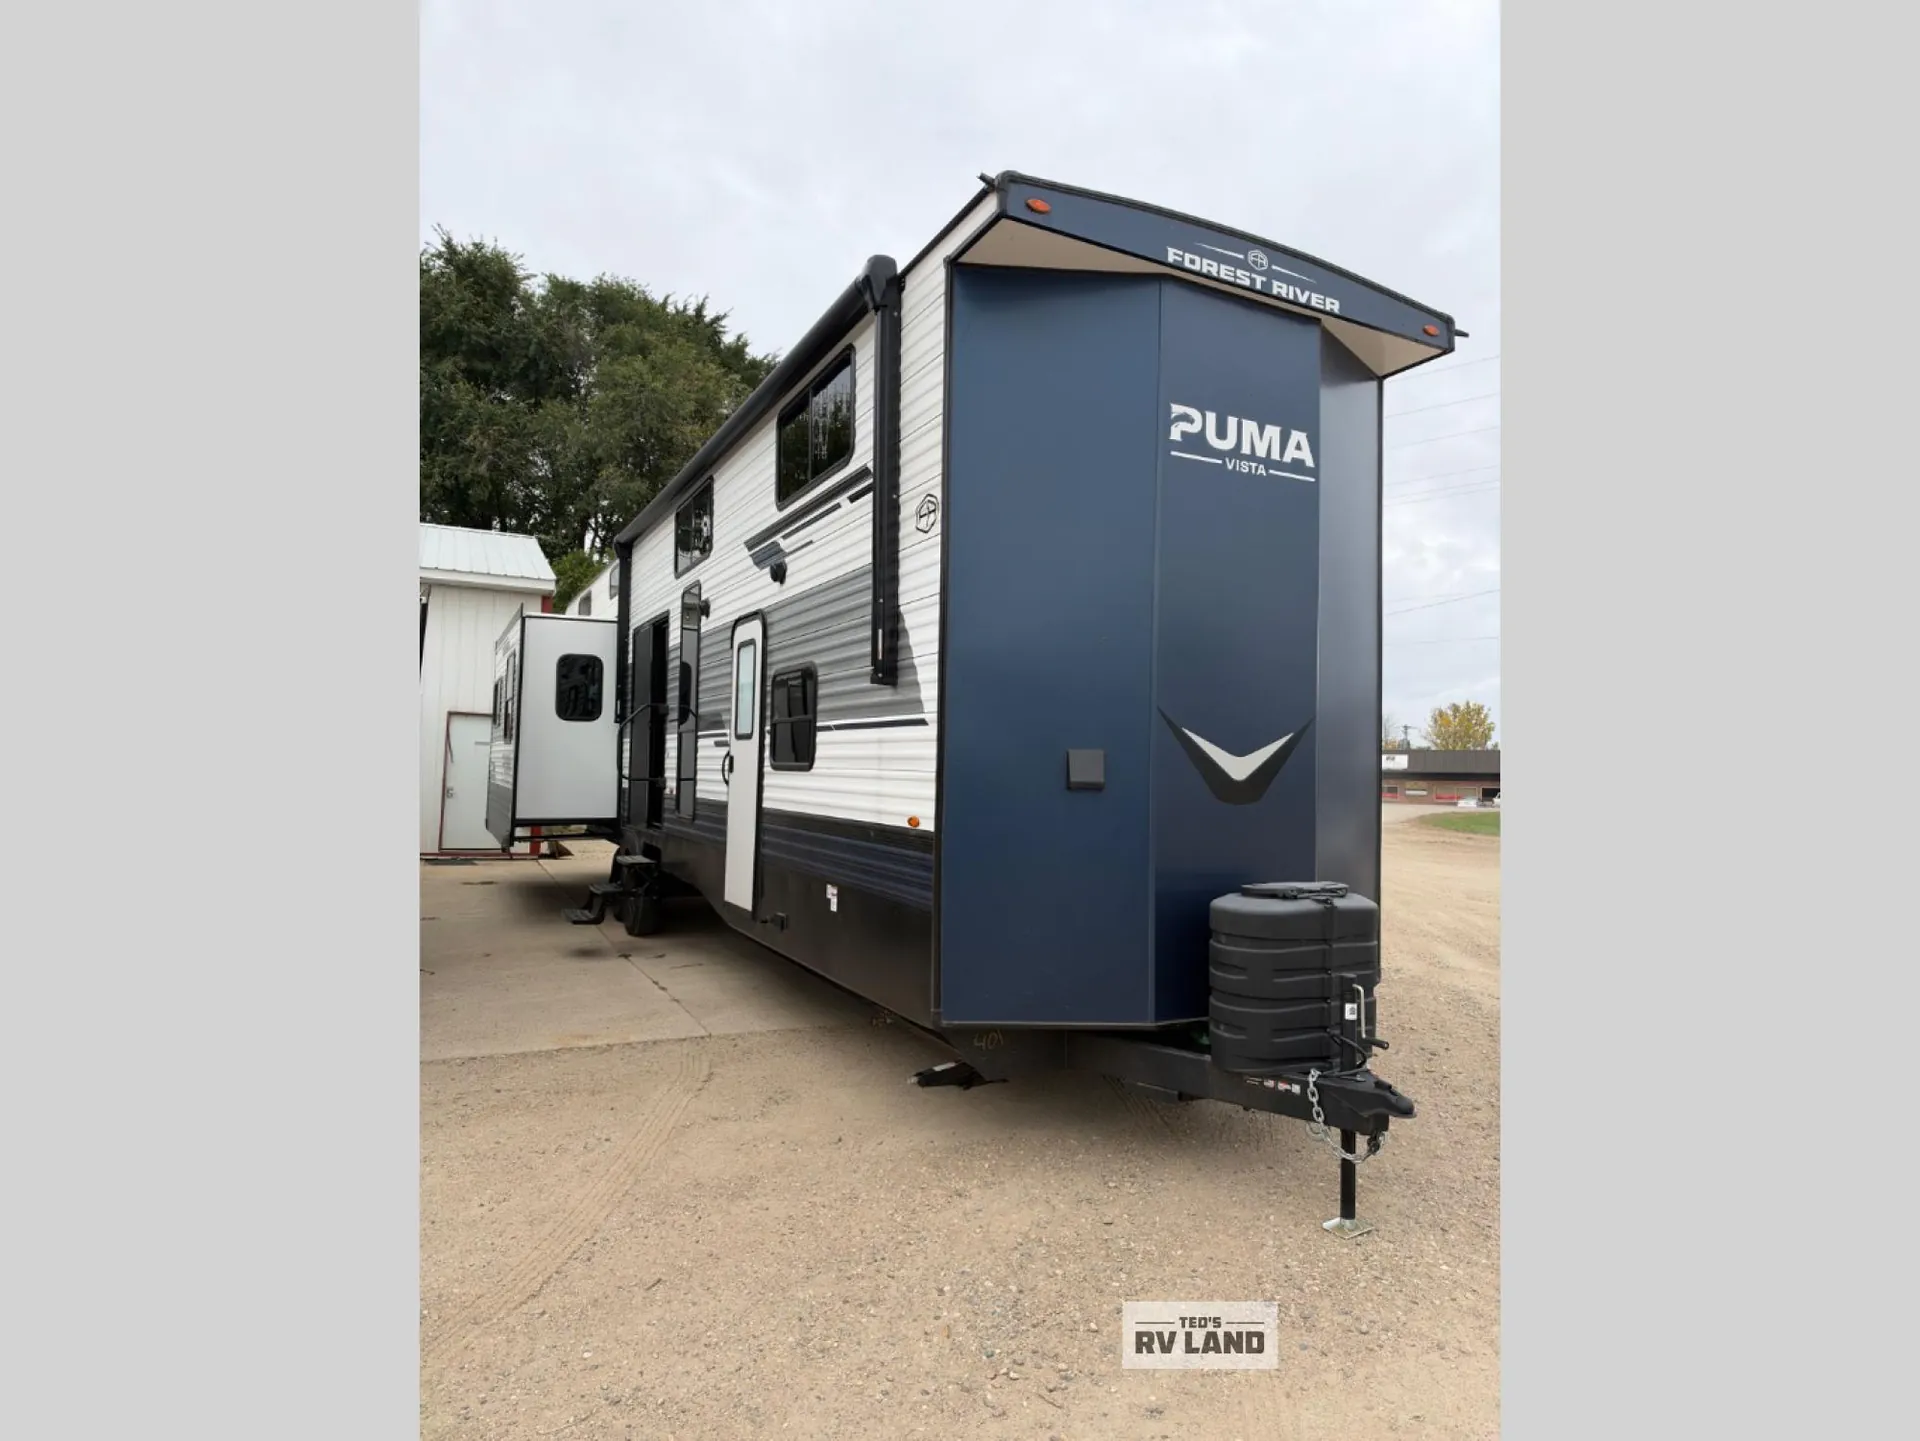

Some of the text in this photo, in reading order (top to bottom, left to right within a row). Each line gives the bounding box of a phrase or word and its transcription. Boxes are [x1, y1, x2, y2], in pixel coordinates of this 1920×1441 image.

[1166, 246, 1341, 314] FOREST RIVER
[1169, 403, 1315, 468] PUMA
[1225, 457, 1267, 476] VISTA
